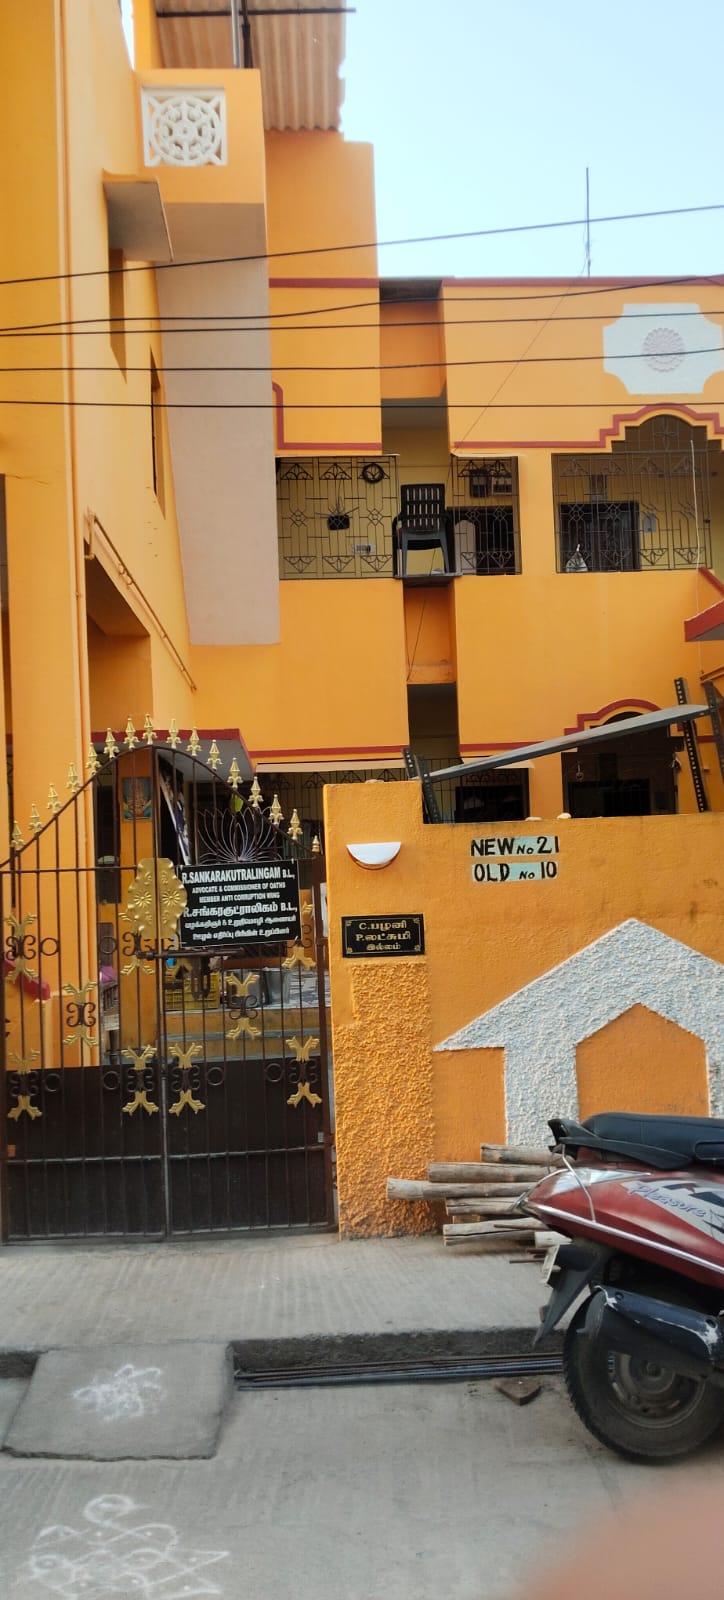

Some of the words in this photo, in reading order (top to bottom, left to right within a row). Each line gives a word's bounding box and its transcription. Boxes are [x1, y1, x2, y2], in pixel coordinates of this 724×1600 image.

[471, 837, 515, 856] NEW
[516, 844, 534, 854] No
[537, 836, 559, 854] 21
[181, 866, 281, 884] R.SANKARAKUTRALINGAM
[474, 863, 510, 882] OLD
[519, 870, 535, 880] No
[541, 861, 557, 879] 10
[192, 885, 218, 894] ADVOCATE
[223, 883, 261, 892] COMMISSIONER
[269, 881, 286, 889] OATHS
[199, 895, 220, 904] MEMBER
[221, 894, 233, 902] ANTI
[234, 892, 266, 901] CORRUPTION
[266, 891, 281, 899] WING
[358, 920, 407, 932] C.பழனி
[630, 1182, 706, 1218] Pleasure
